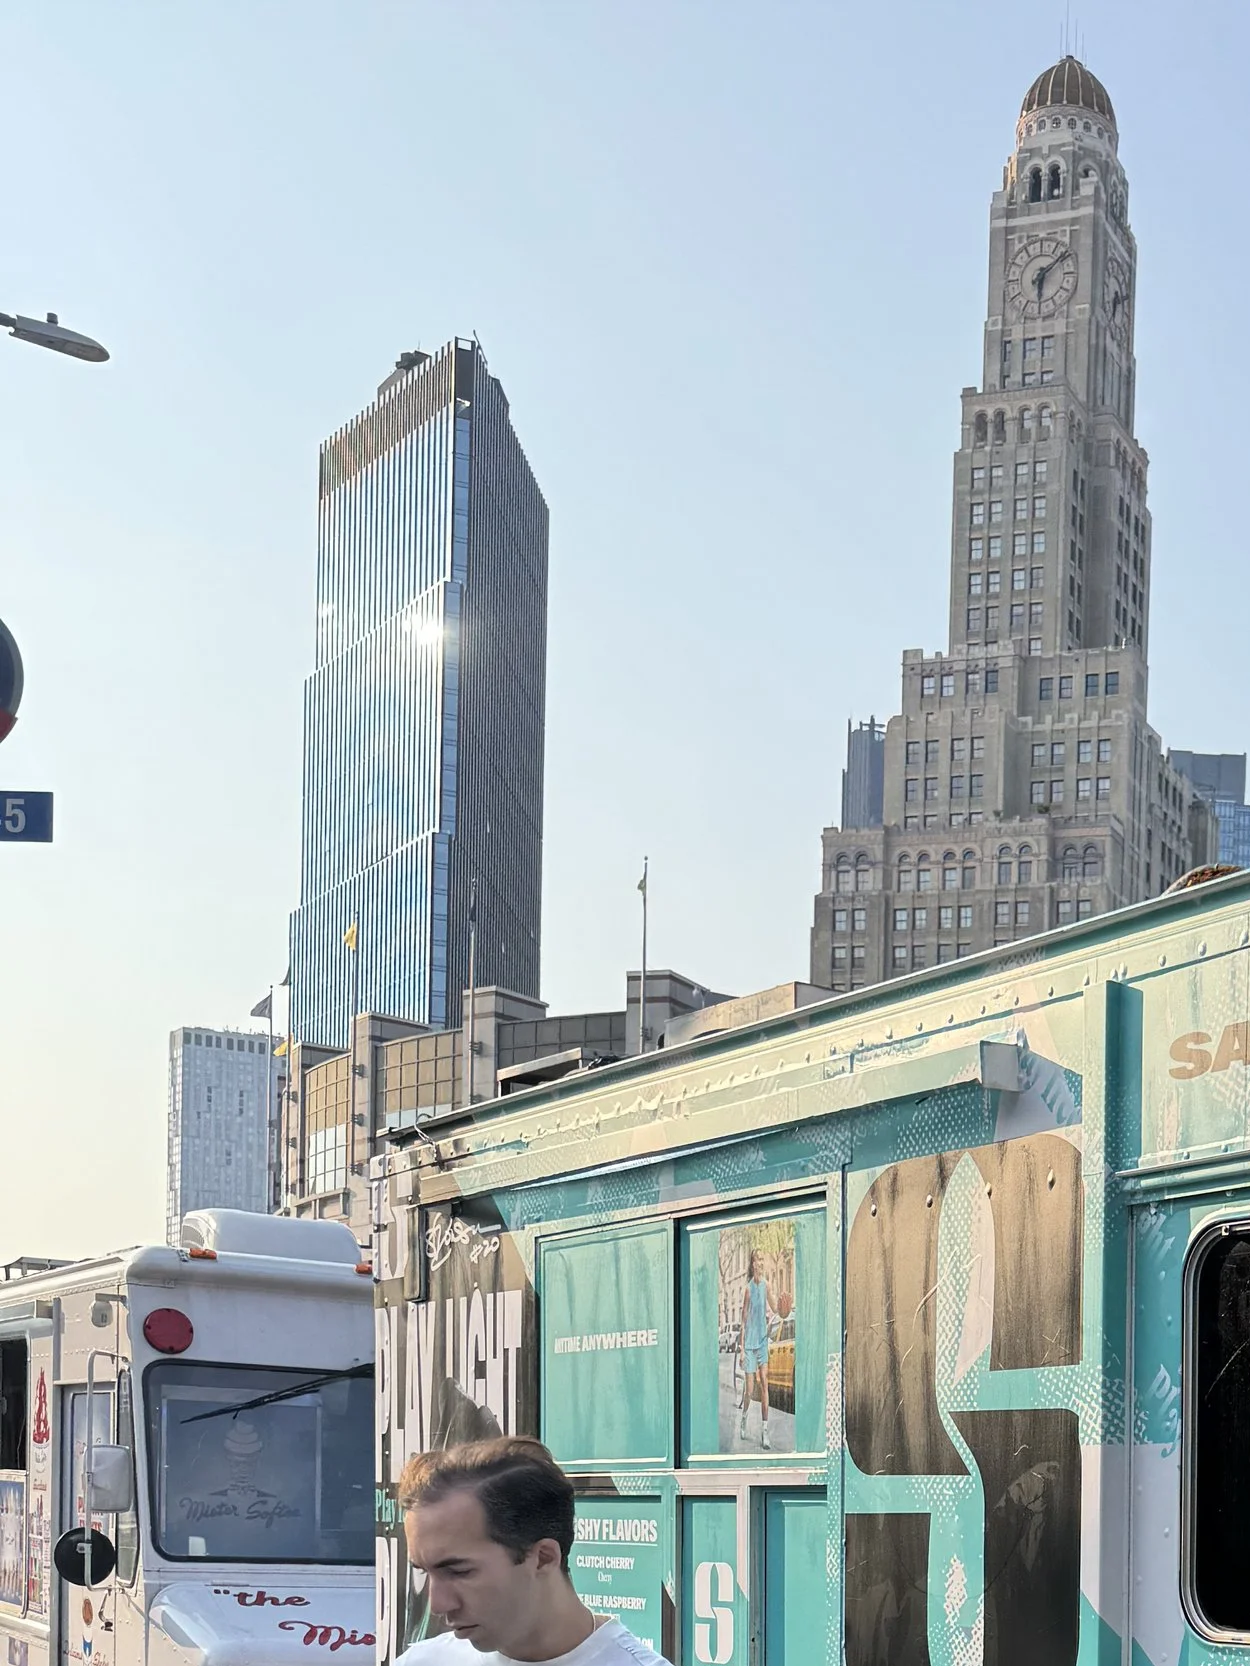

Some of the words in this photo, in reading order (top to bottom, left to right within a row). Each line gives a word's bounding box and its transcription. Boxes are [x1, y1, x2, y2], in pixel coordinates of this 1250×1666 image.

[0, 798, 26, 833] 5
[581, 1329, 658, 1352] ANYWHERE
[375, 1302, 437, 1483] PLAY
[375, 1488, 396, 1530] Play
[602, 1519, 658, 1542] FLAVORS
[576, 1555, 605, 1569] CLUTCH
[605, 1557, 635, 1570] CHERRY
[584, 1594, 602, 1608] BLUE
[603, 1595, 646, 1611] RASPBERRY
